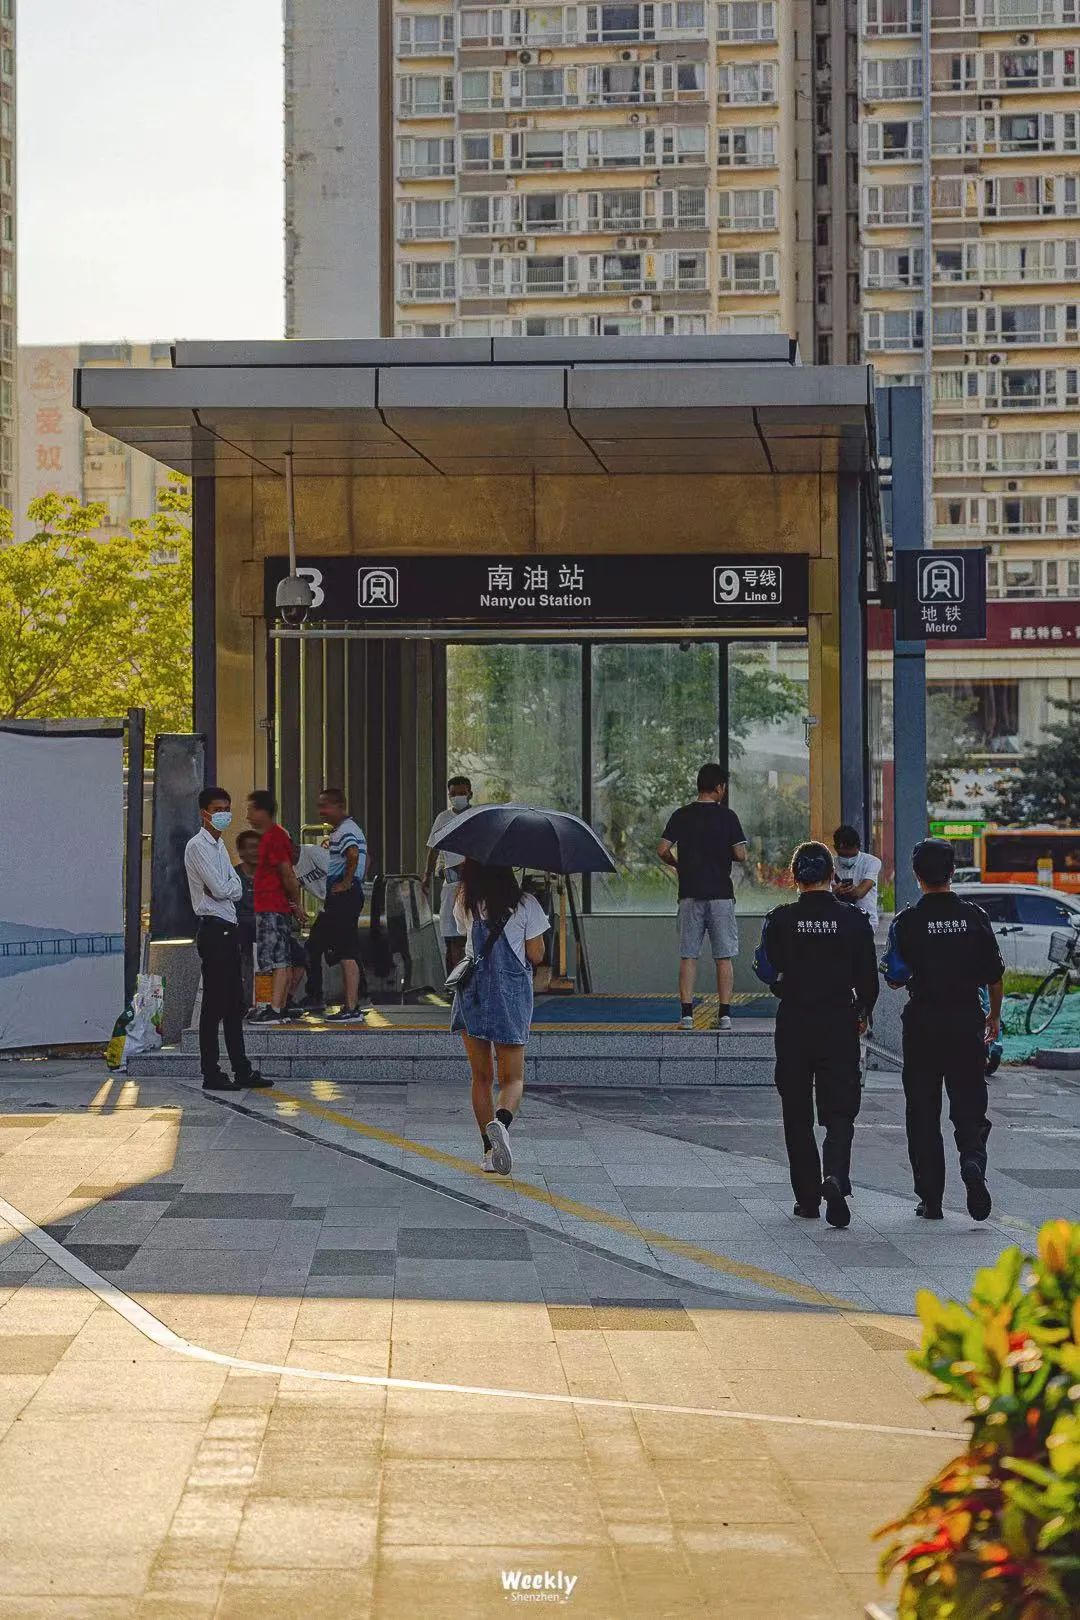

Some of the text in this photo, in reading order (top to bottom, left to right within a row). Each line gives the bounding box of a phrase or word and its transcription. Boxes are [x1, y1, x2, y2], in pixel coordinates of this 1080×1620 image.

[488, 564, 585, 591] 南油站
[719, 569, 777, 601] 9 号线
[480, 594, 592, 609] Nanyou Station
[744, 591, 777, 601] Line 9
[921, 605, 961, 621] 地铁
[925, 622, 957, 633] Metro
